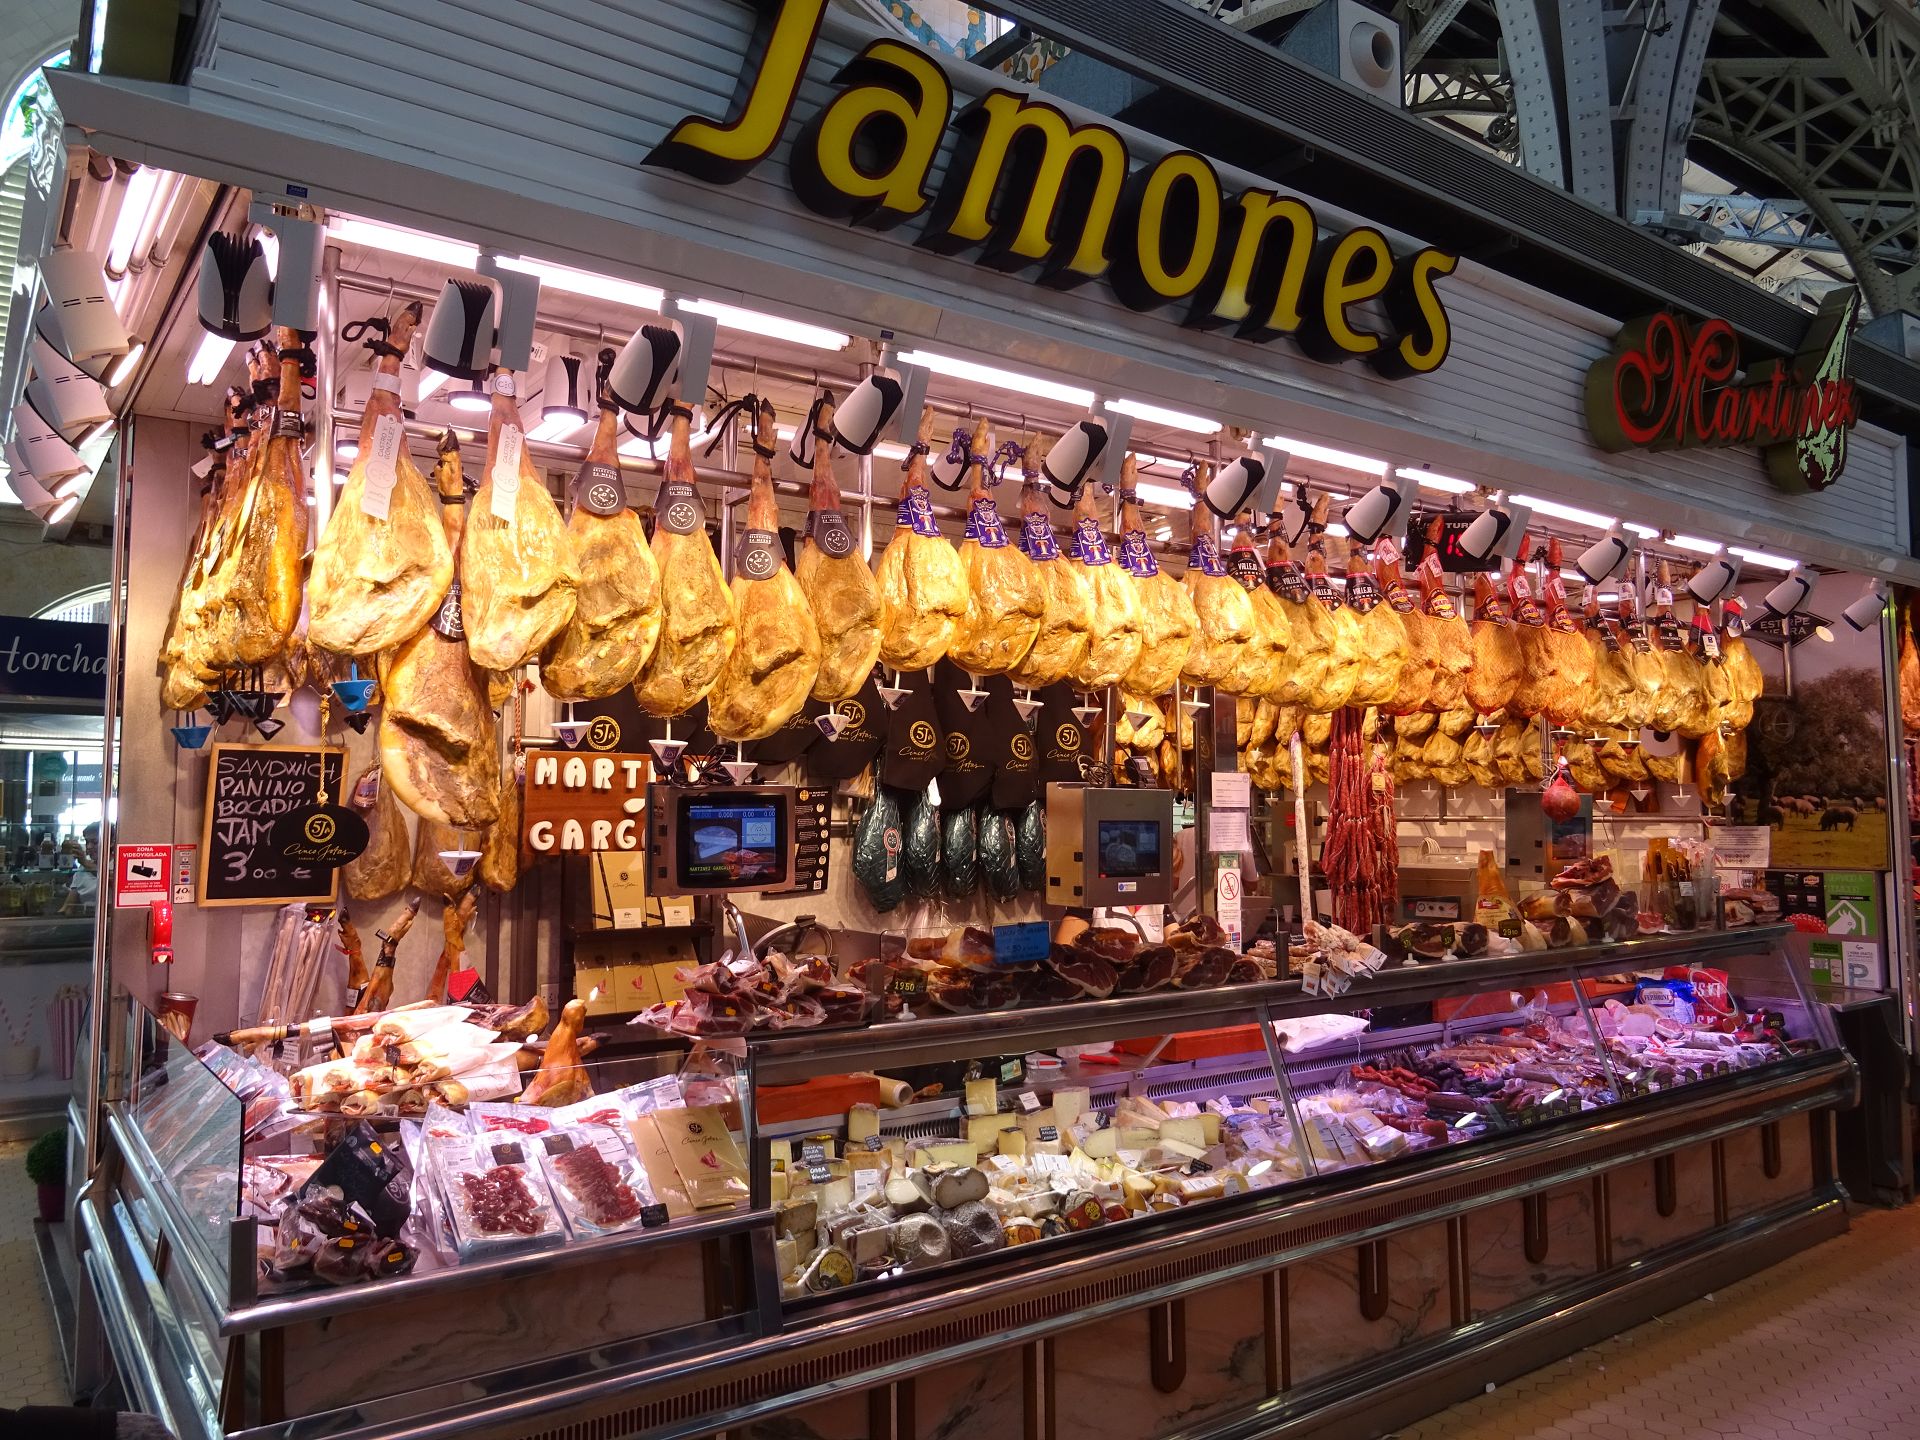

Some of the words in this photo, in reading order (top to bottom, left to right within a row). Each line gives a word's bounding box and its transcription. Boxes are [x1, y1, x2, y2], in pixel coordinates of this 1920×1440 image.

[668, 0, 1456, 374] Jamones
[1759, 615, 1810, 630] ESTRPE
[958, 759, 985, 773] Jotas
[219, 776, 306, 798] PANINO
[529, 818, 645, 851] GARG
[283, 843, 318, 856] Cinco
[316, 844, 356, 862] Jotas
